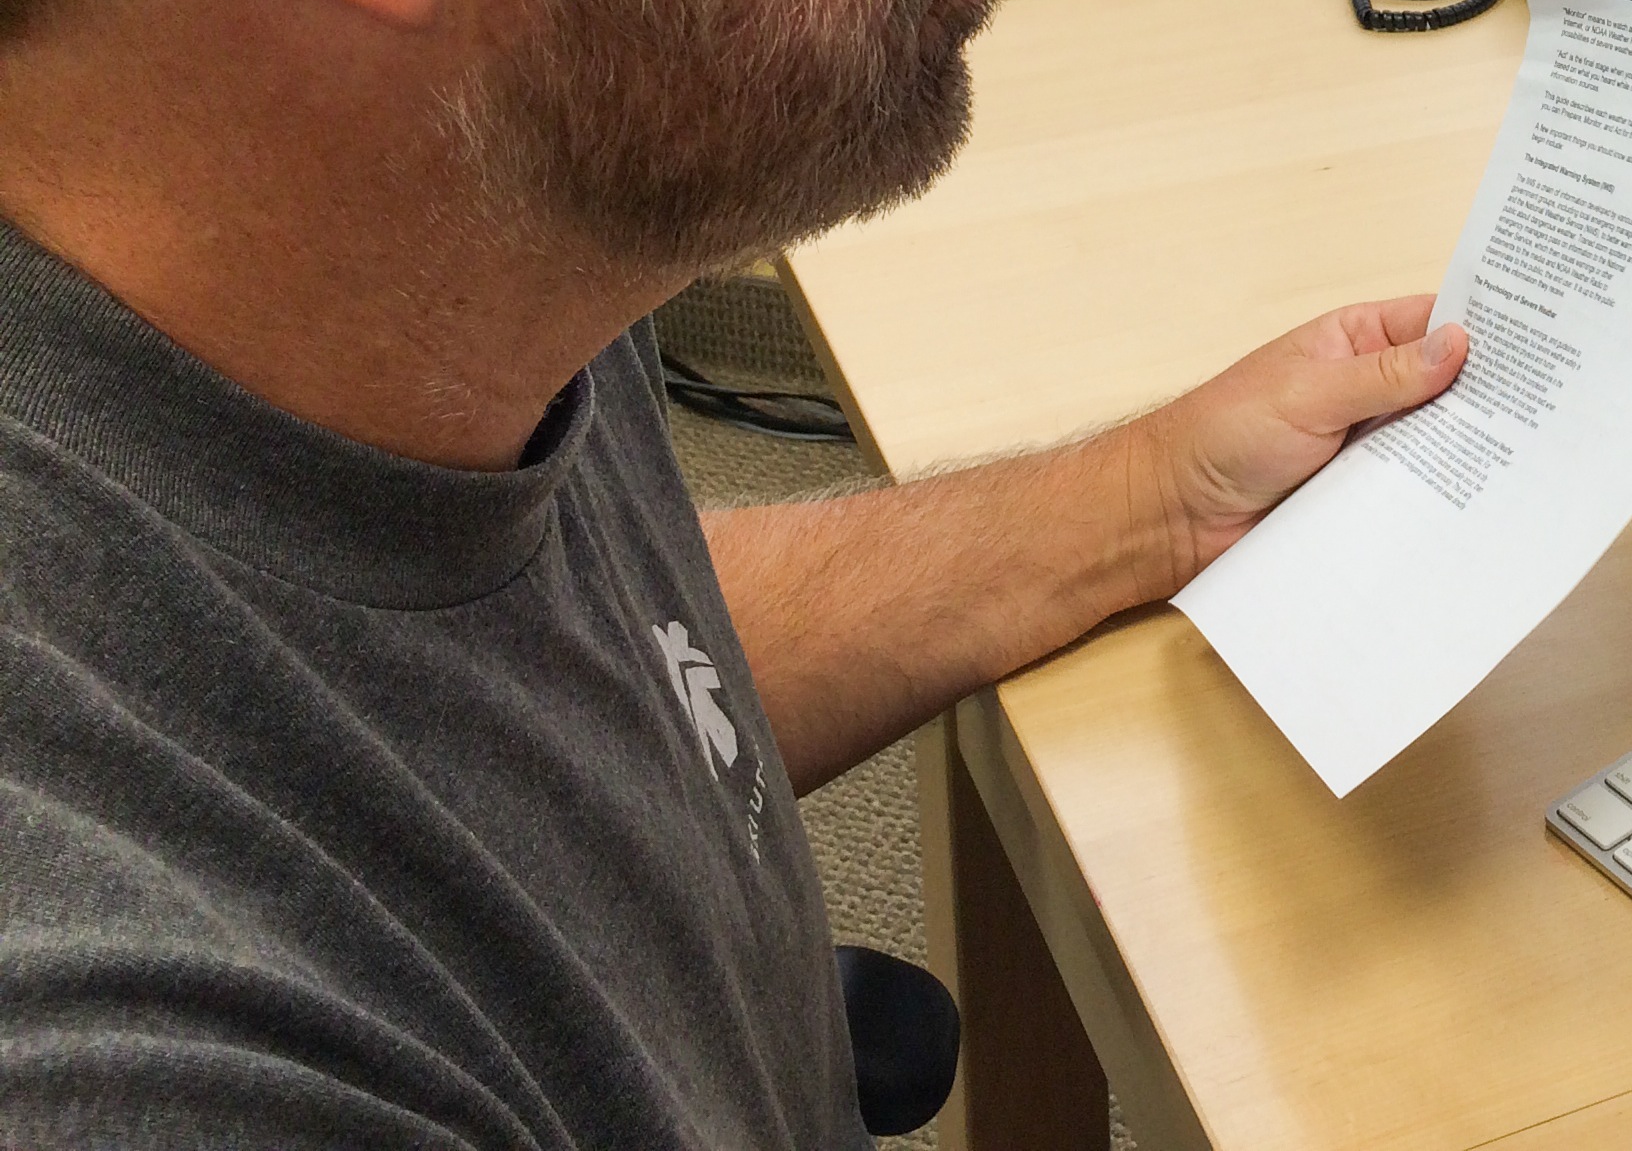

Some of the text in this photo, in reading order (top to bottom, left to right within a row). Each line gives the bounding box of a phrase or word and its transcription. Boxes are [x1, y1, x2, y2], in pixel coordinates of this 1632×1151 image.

[1524, 152, 1534, 162] The
[1560, 166, 1581, 180] Warning
[1582, 174, 1601, 187] System
[1474, 275, 1484, 285] The
[1483, 279, 1514, 298] Psychology
[1521, 296, 1538, 308] Severe
[1615, 771, 1631, 785] shift
[1566, 802, 1591, 822] control
